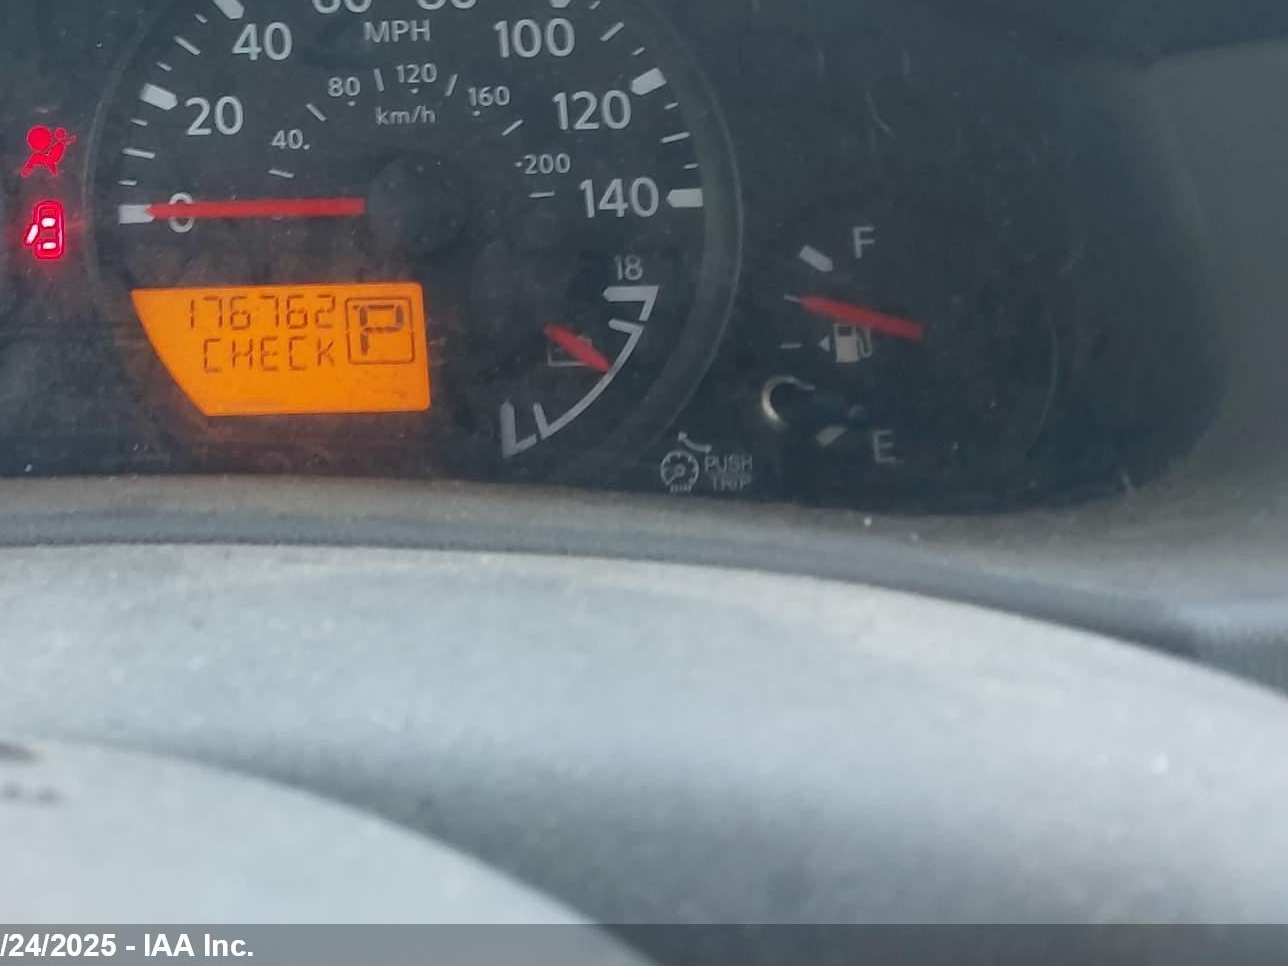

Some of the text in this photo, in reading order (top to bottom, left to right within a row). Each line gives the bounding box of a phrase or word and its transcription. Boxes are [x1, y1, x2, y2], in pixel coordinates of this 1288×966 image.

[232, 21, 292, 61] 40
[363, 19, 431, 43] MPH
[493, 17, 575, 58] 100
[327, 76, 361, 97] 80
[395, 63, 437, 84] 120
[467, 85, 510, 107] 160
[552, 89, 632, 131] 120
[185, 95, 244, 135] 20
[375, 106, 436, 126] km/h
[168, 192, 195, 233] 0
[579, 177, 659, 218] 140
[852, 226, 875, 259] F
[614, 255, 644, 280] 18
[188, 293, 336, 331] 176762
[352, 303, 404, 355] P
[202, 335, 335, 373] CHECK
[704, 454, 753, 473] PUSH
[872, 429, 901, 464] E
